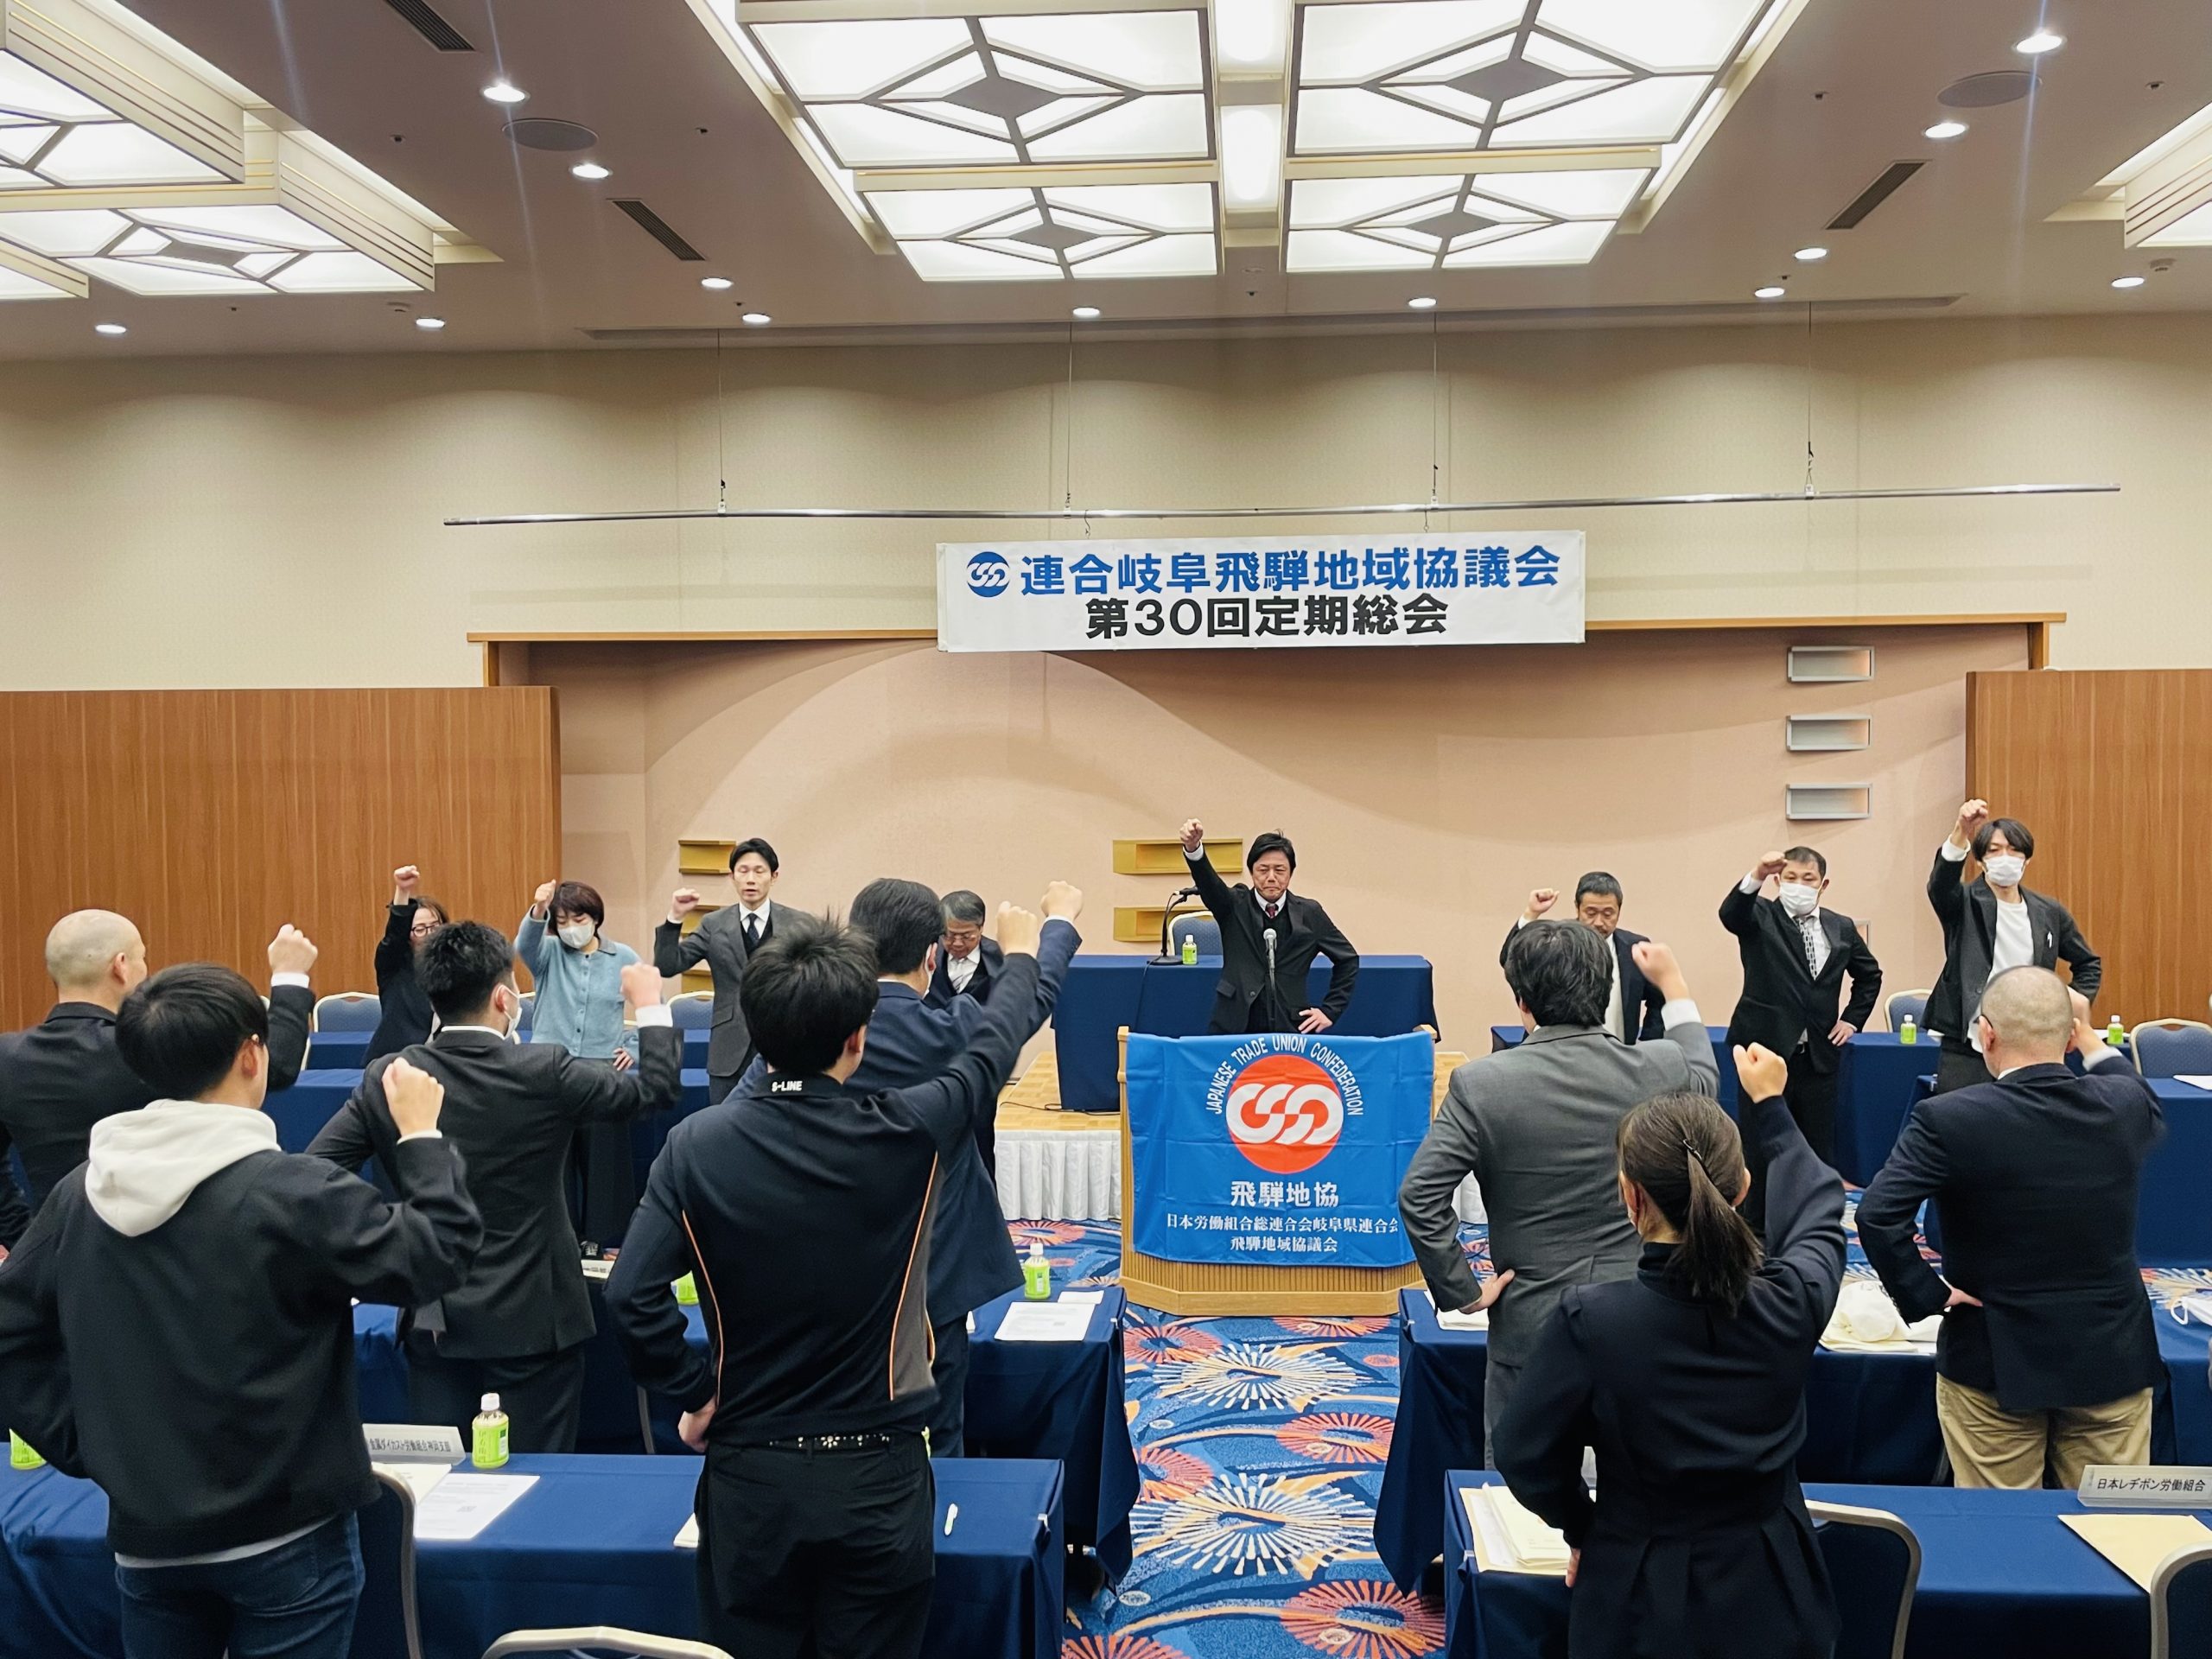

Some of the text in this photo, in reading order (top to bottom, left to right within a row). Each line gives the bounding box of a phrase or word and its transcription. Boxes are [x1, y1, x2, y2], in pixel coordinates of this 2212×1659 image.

[1020, 544, 1561, 595] 連合岐阜飛騨地域協議会
[1085, 593, 1449, 639] 第30回定期総会
[1205, 1035, 1363, 1116] JAPANESE TRADE UNION CONFEDERATION
[1230, 1180, 1340, 1208] 飛騨地協
[1230, 1236, 1338, 1253] 飛騨地域協議会
[2097, 1478, 2206, 1491] 日本レヂボン労働組合
